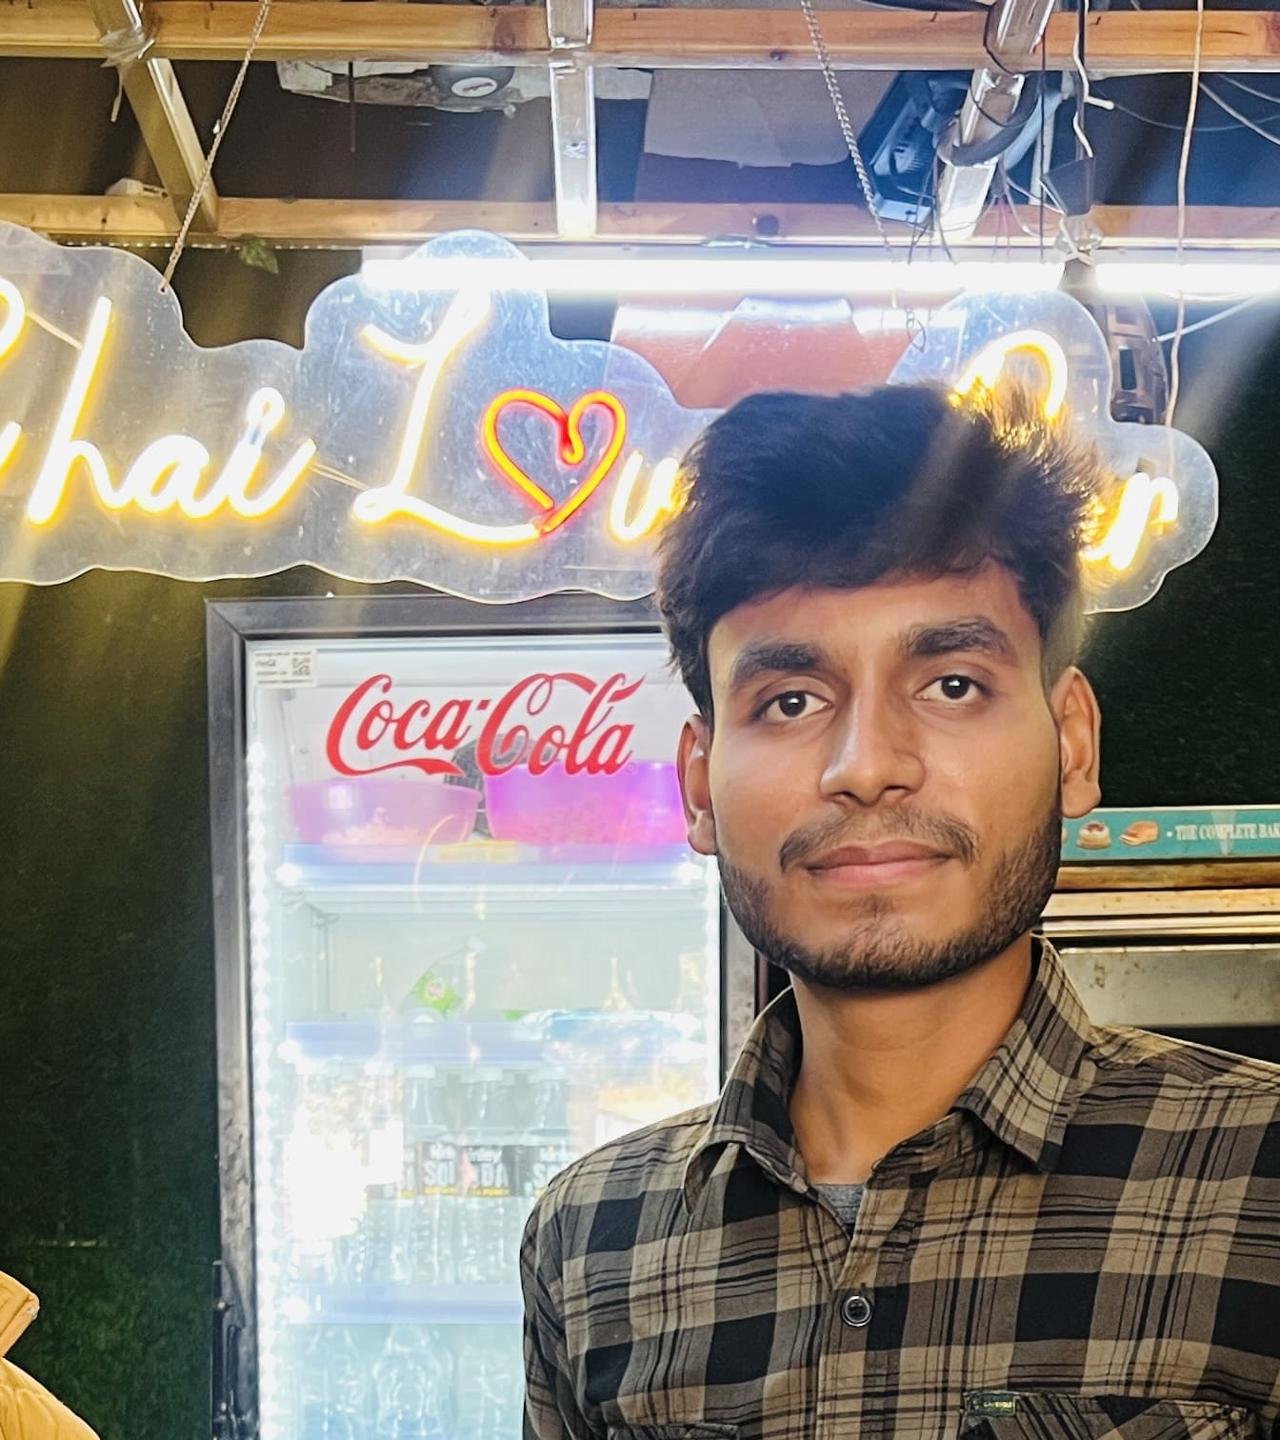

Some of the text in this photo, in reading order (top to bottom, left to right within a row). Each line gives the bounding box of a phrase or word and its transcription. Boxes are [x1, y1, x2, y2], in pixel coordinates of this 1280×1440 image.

[326, 672, 646, 777] Coca-Cola
[1175, 825, 1198, 841] THE
[1199, 823, 1258, 840] COMPLETE
